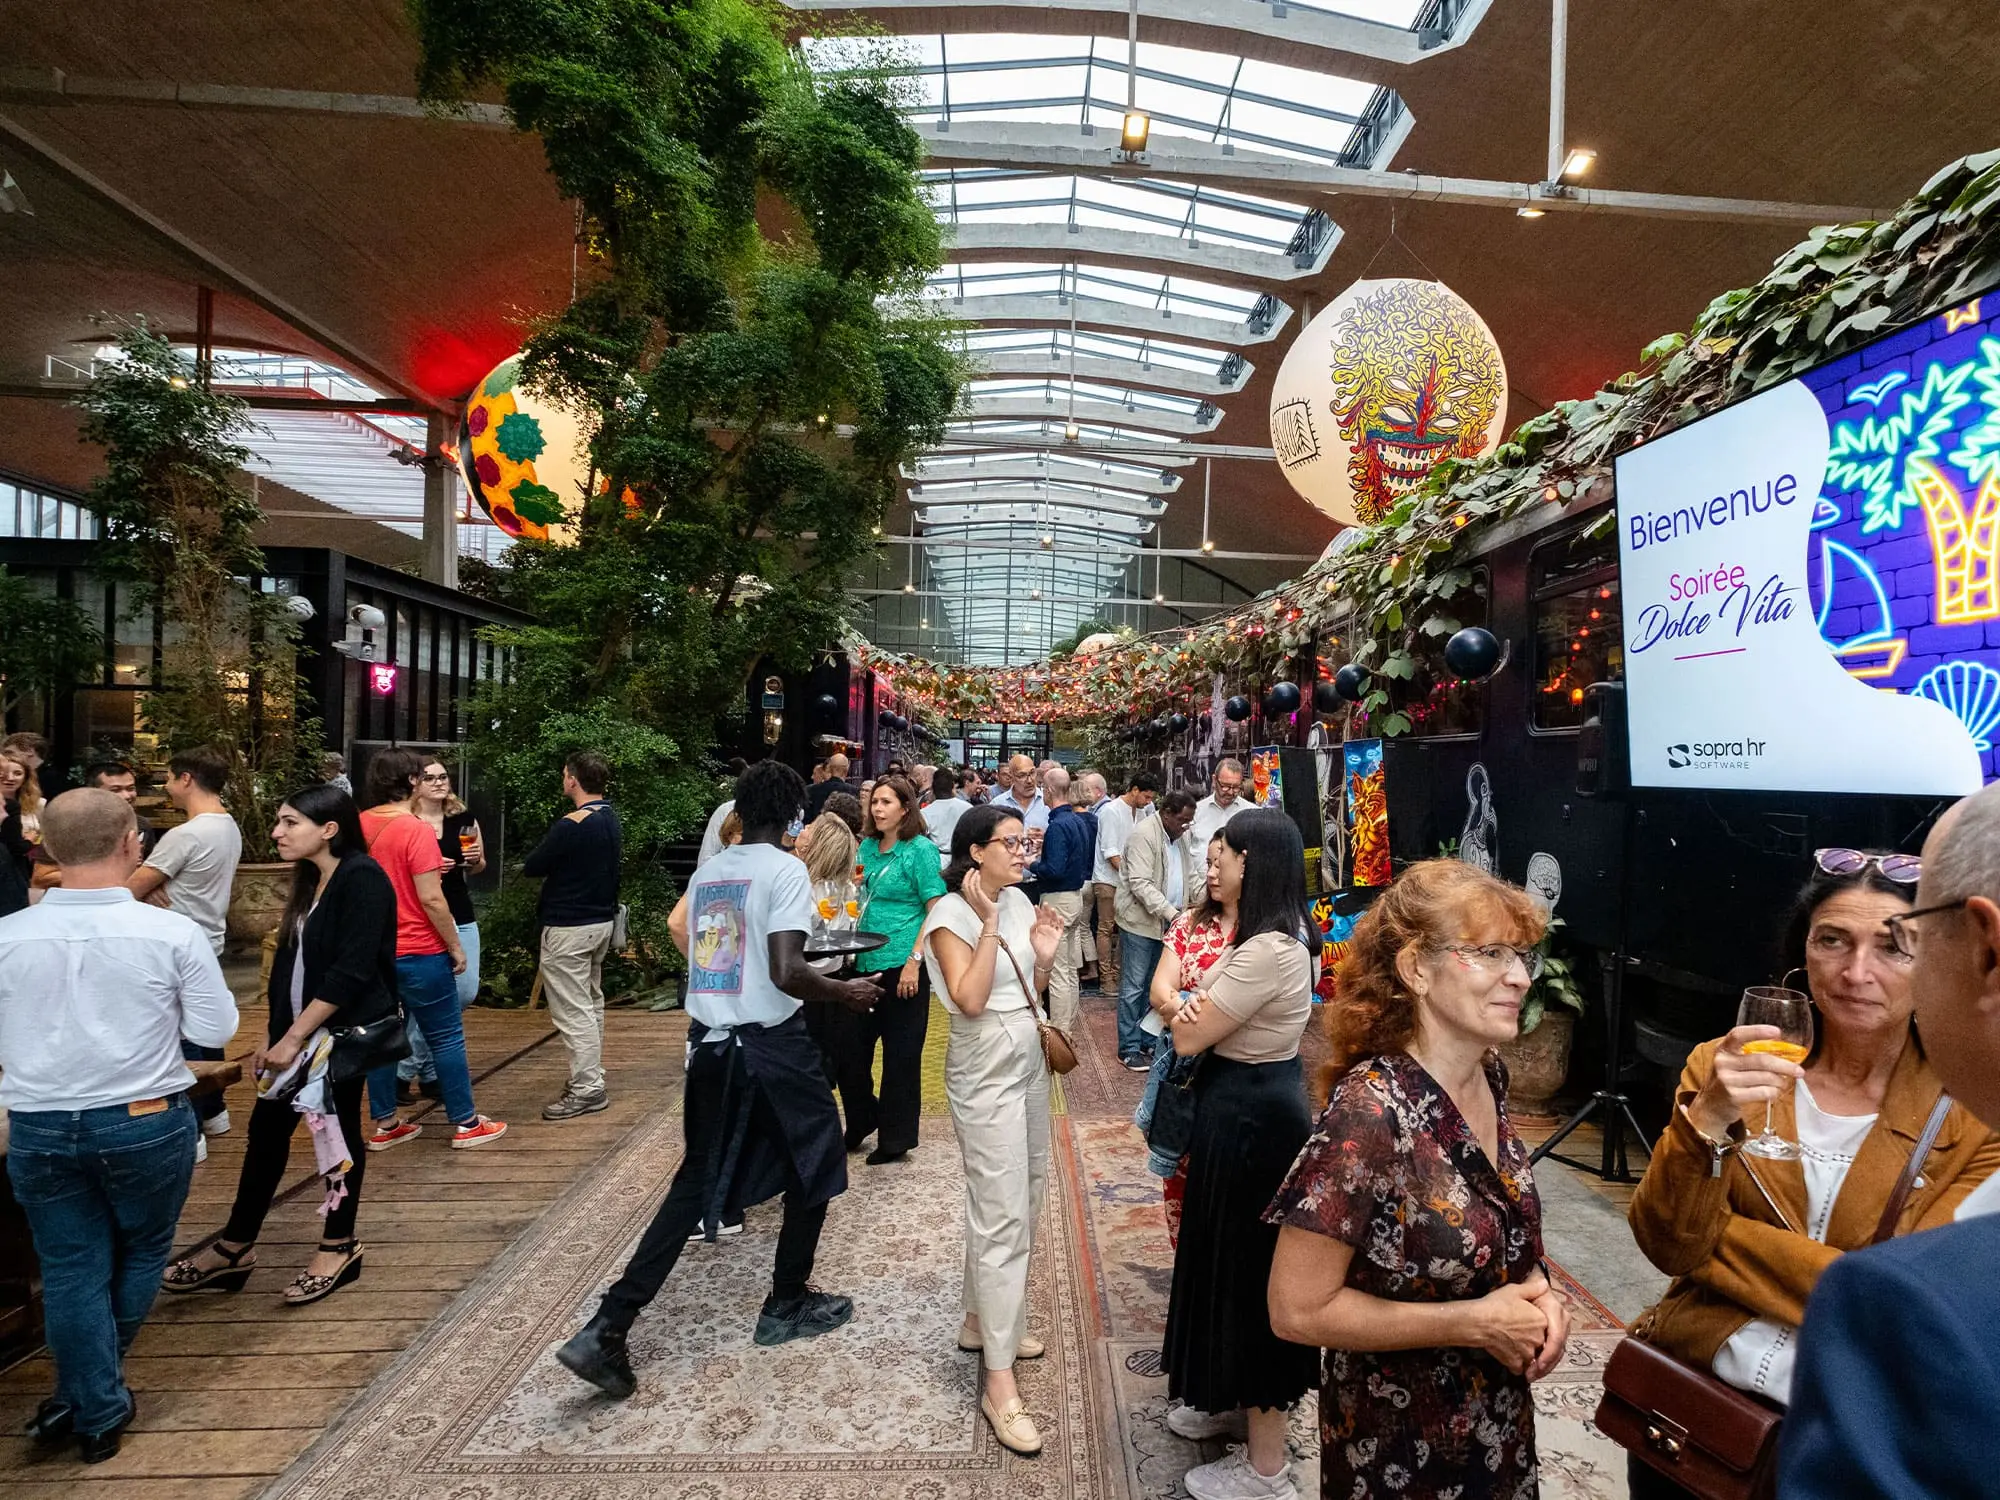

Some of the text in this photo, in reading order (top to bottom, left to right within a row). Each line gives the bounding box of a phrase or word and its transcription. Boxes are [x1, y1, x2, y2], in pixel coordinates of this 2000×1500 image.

[1630, 473, 1798, 551] Bienvenue
[1669, 562, 1746, 602] Soirée
[1630, 574, 1801, 654] Dolce Vita
[1693, 737, 1767, 760] sopra hr
[1693, 760, 1750, 770] SOFTWARE
